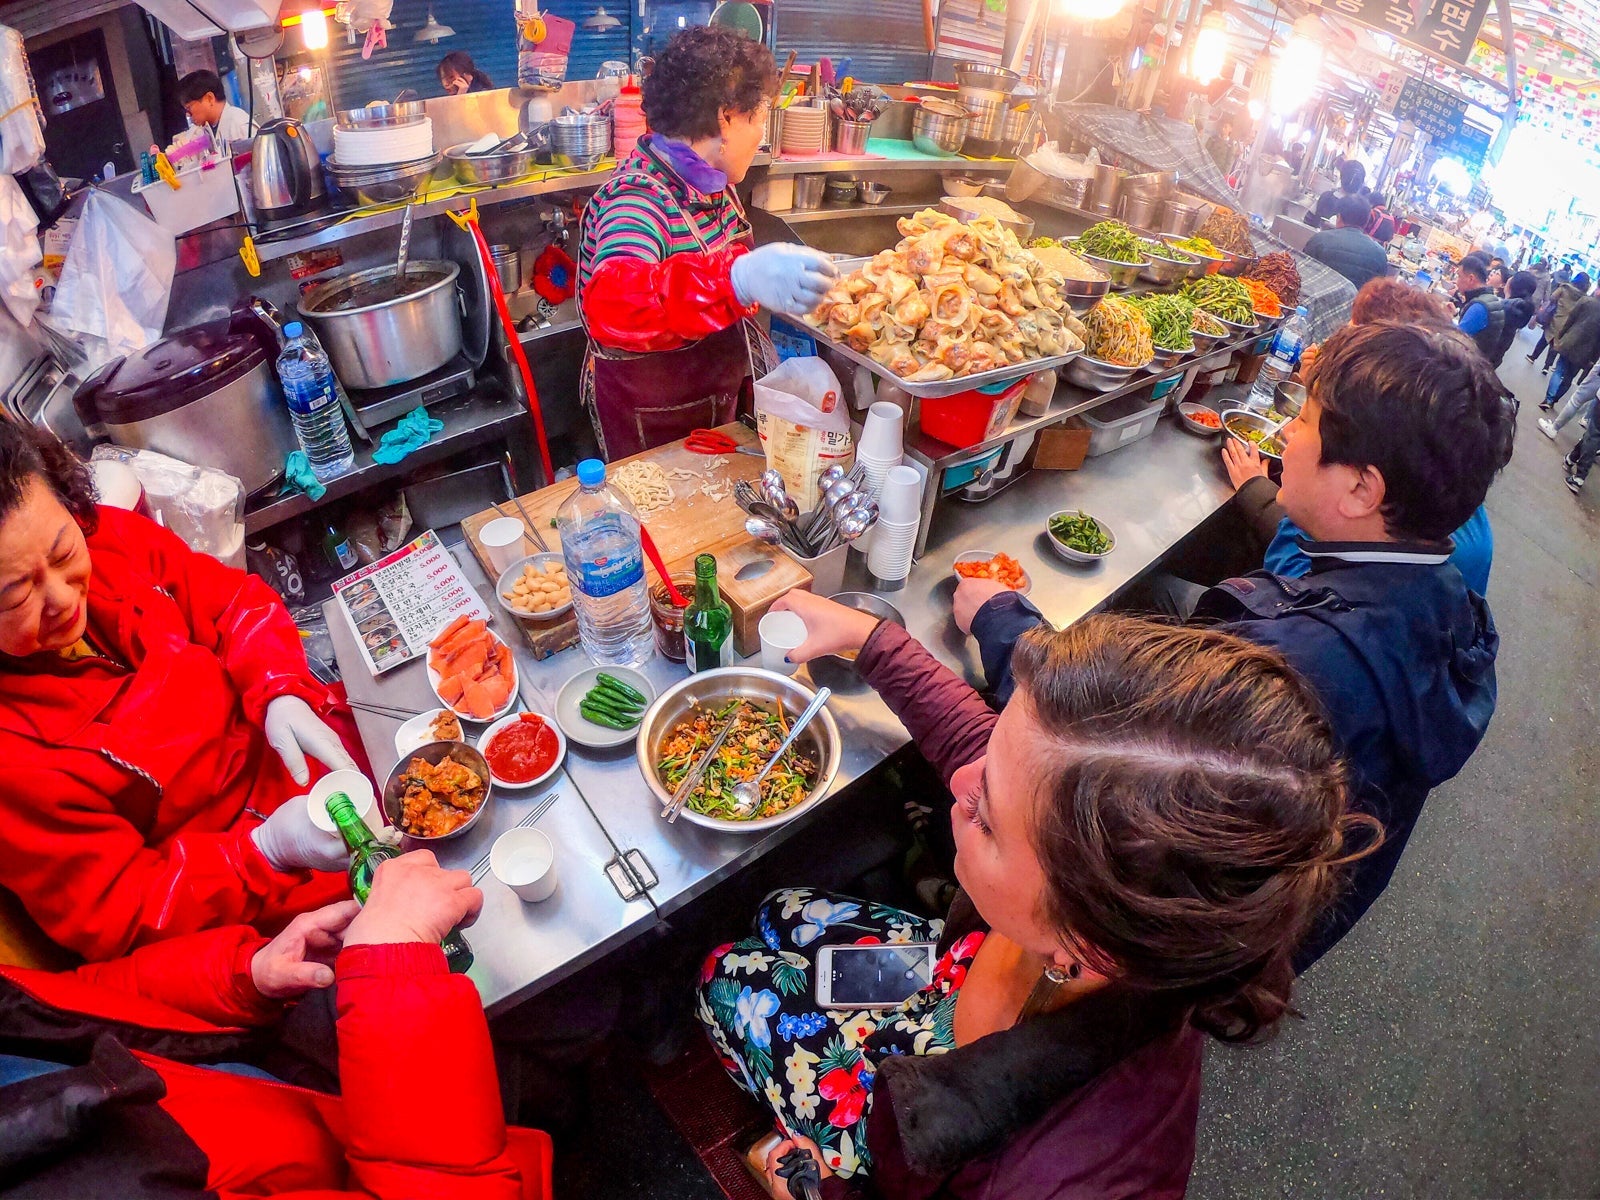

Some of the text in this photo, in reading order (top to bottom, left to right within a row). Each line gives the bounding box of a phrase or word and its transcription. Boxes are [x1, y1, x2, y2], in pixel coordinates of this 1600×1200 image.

[1388, 83, 1400, 94] 15
[419, 554, 441, 568] 5,000
[426, 564, 448, 580] 5,000
[434, 575, 455, 590] 5,000
[441, 586, 463, 601] 5,000
[449, 597, 471, 612] 5,000
